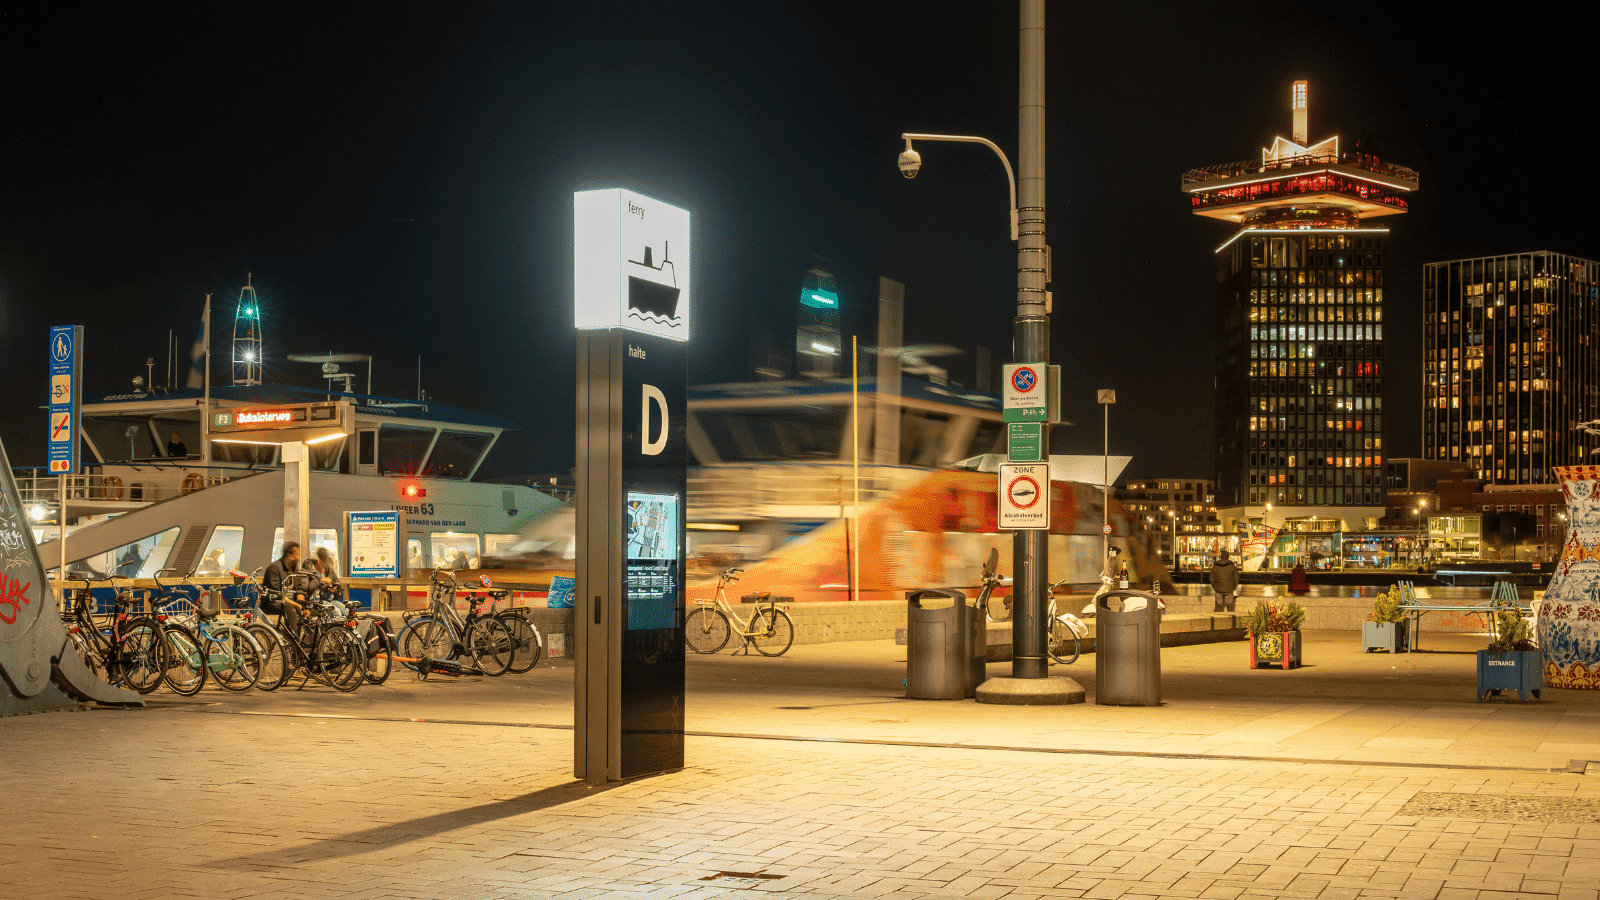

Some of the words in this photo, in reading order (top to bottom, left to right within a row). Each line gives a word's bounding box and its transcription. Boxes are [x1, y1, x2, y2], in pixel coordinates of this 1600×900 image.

[628, 200, 645, 220] ferry
[628, 344, 646, 360] halte
[218, 415, 228, 424] F3
[641, 383, 669, 456] D
[421, 503, 434, 516] 63
